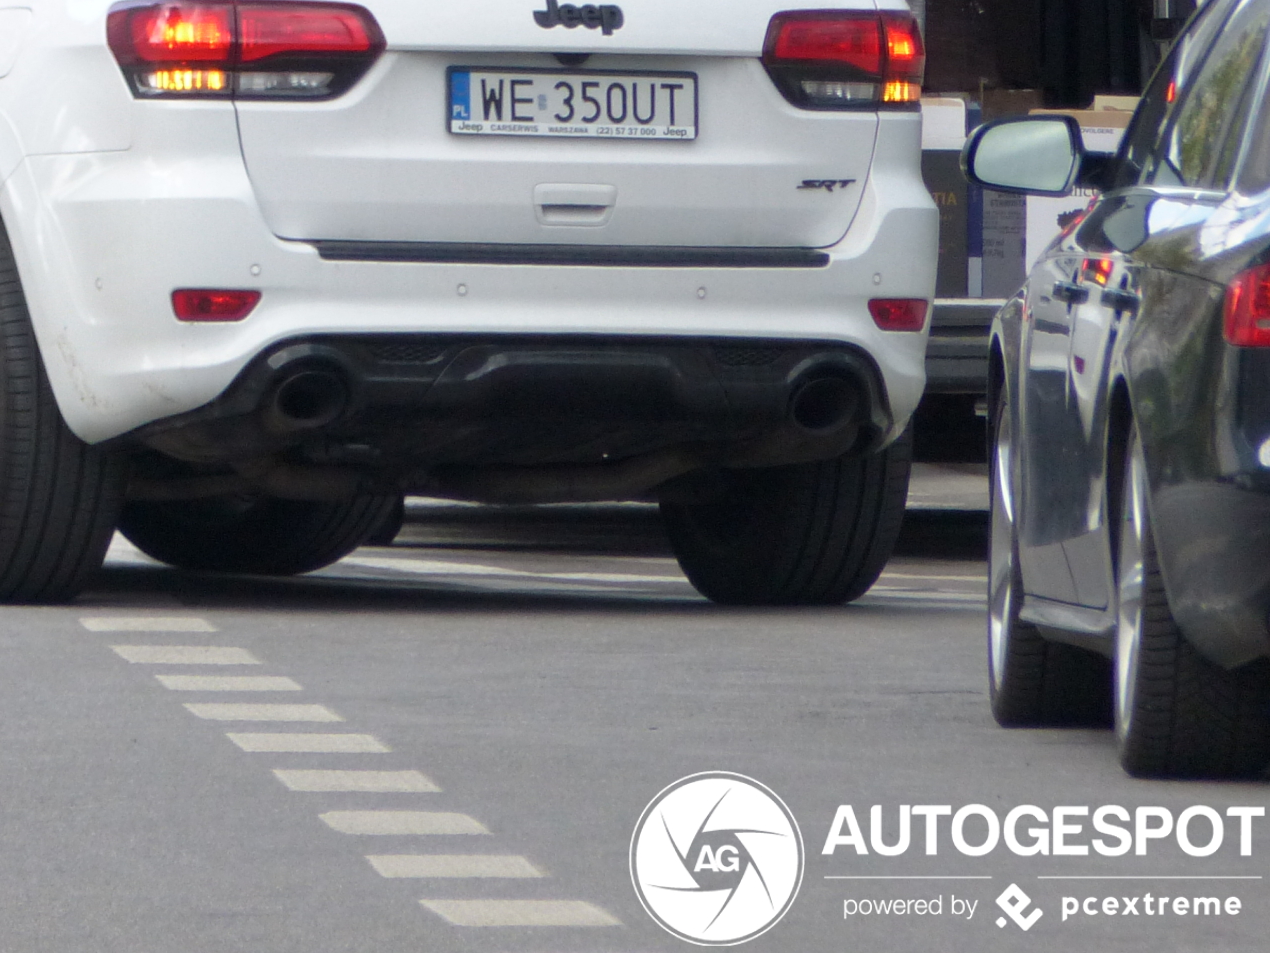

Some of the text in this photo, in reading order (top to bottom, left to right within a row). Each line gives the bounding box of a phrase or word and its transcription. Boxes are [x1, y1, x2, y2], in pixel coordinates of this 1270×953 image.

[481, 79, 684, 126] WE 350UT
[458, 122, 483, 133] Jeep
[663, 127, 687, 137] Jeep
[797, 179, 856, 192] SRT
